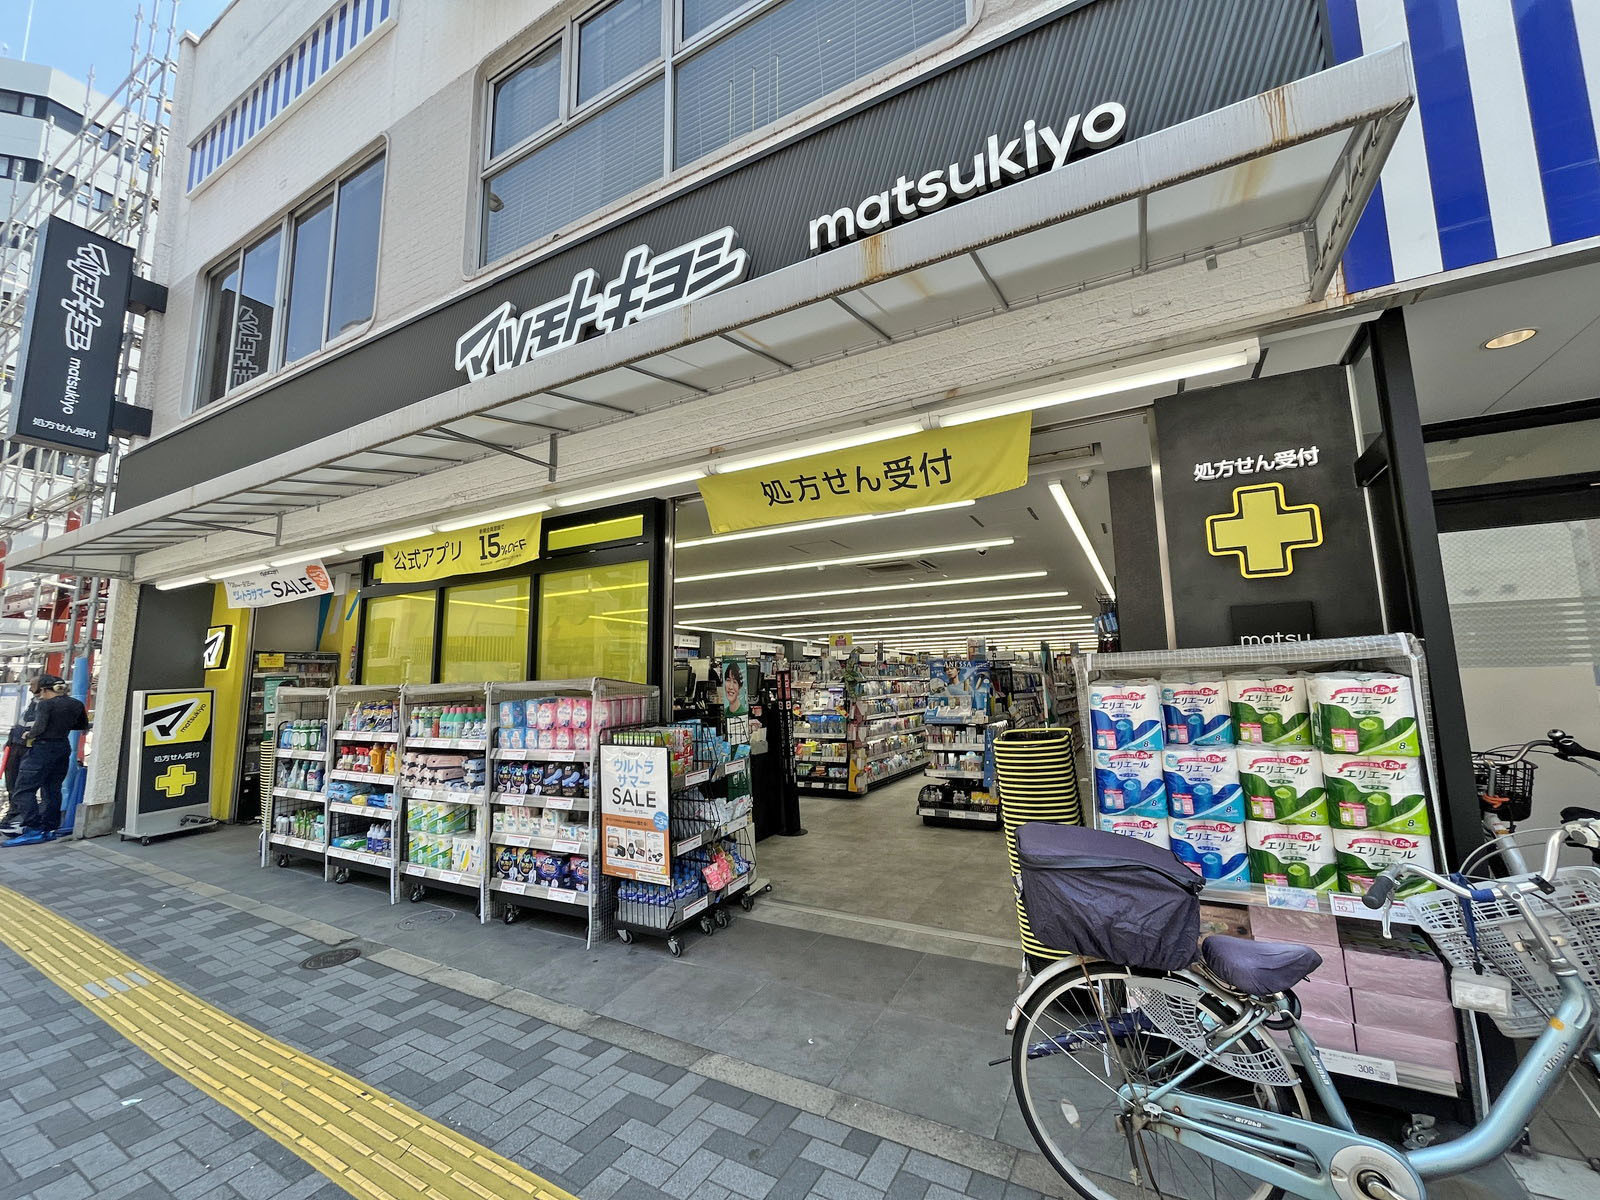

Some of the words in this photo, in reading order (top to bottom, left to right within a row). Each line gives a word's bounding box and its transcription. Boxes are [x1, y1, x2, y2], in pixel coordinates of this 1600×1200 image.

[807, 101, 1127, 251] matsukiyo
[455, 225, 748, 381] マツモトキヨシ
[60, 357, 82, 415] matsukiyo
[32, 417, 98, 439] 処方せん受付
[1194, 445, 1320, 482] 処方せん受付
[760, 447, 953, 506] 処方せん受付
[479, 532, 527, 560] 15%OFF
[393, 540, 463, 571] 公式アプリ
[270, 577, 316, 598] SALE
[943, 660, 972, 668] ANESSA
[1099, 701, 1142, 710] エリエール
[1172, 696, 1215, 705] エリエール
[1244, 694, 1293, 704] エリエール
[1336, 696, 1397, 705] エリエール
[181, 703, 207, 733] matsukiyo
[153, 751, 200, 763] 処方せん受付
[614, 759, 654, 774] ウルトラ
[1107, 761, 1150, 770] エリエール
[1175, 764, 1223, 773] エリエール
[1254, 764, 1308, 775] エリエール
[617, 774, 650, 788] サマー
[1344, 770, 1405, 781] エリエール
[612, 787, 657, 808] SALE
[1184, 832, 1233, 842] エリエール
[1265, 842, 1320, 852] エリエール
[1354, 846, 1417, 859] エリエール
[1357, 1063, 1375, 1075] 308
